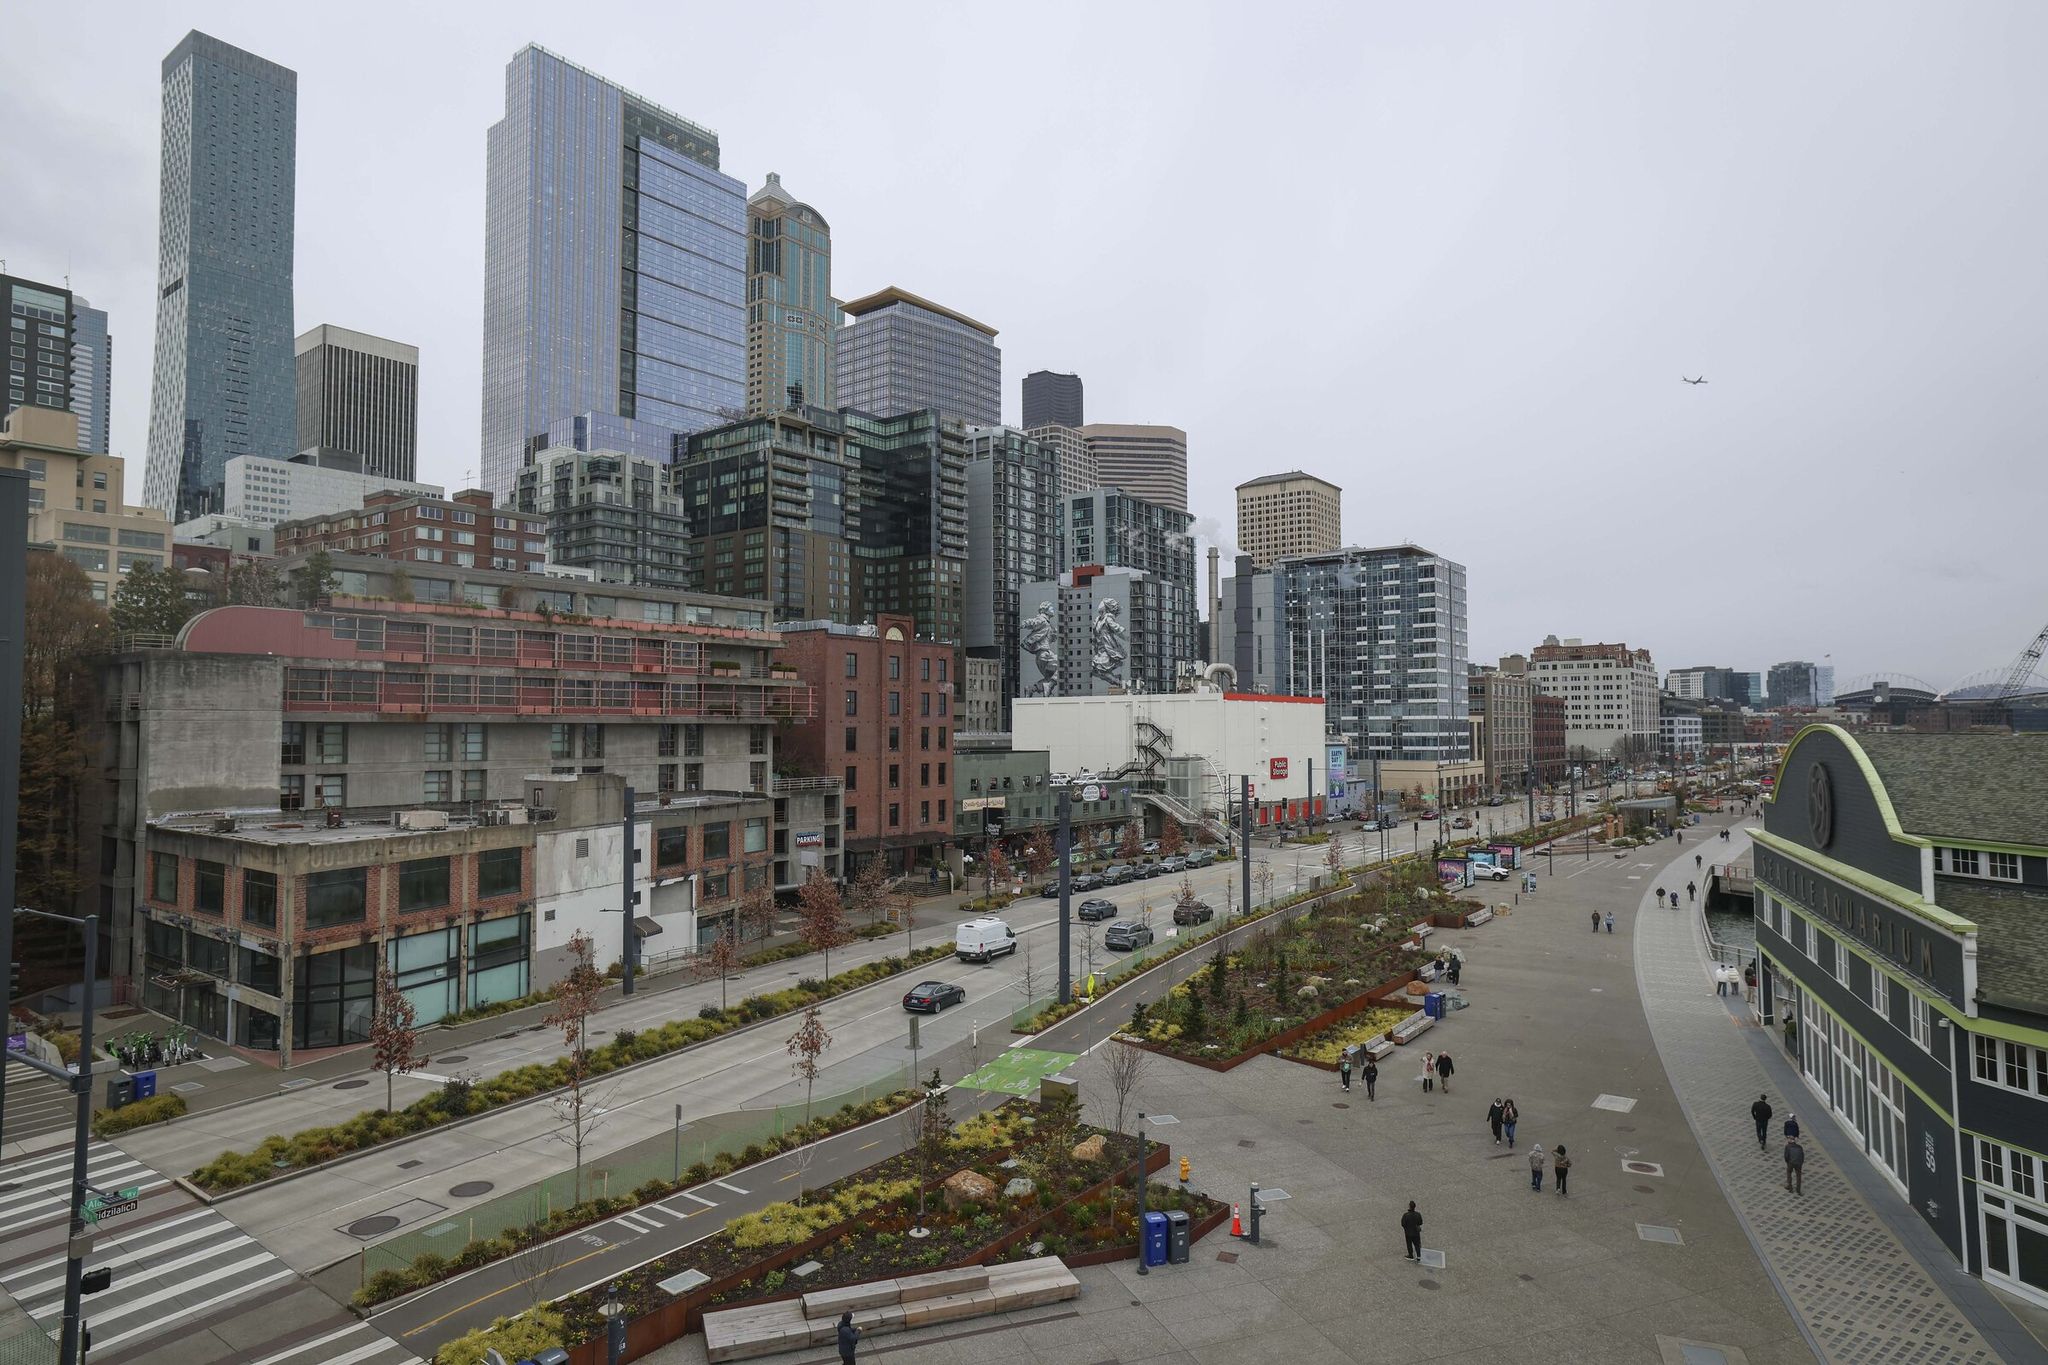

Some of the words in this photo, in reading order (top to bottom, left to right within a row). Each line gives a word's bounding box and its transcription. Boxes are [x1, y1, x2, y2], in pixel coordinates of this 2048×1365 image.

[796, 835, 820, 845] PARKING
[1761, 855, 1817, 907] SEATTLE
[1823, 887, 1933, 977] AQUARIUM
[97, 1203, 136, 1220] idzilalich
